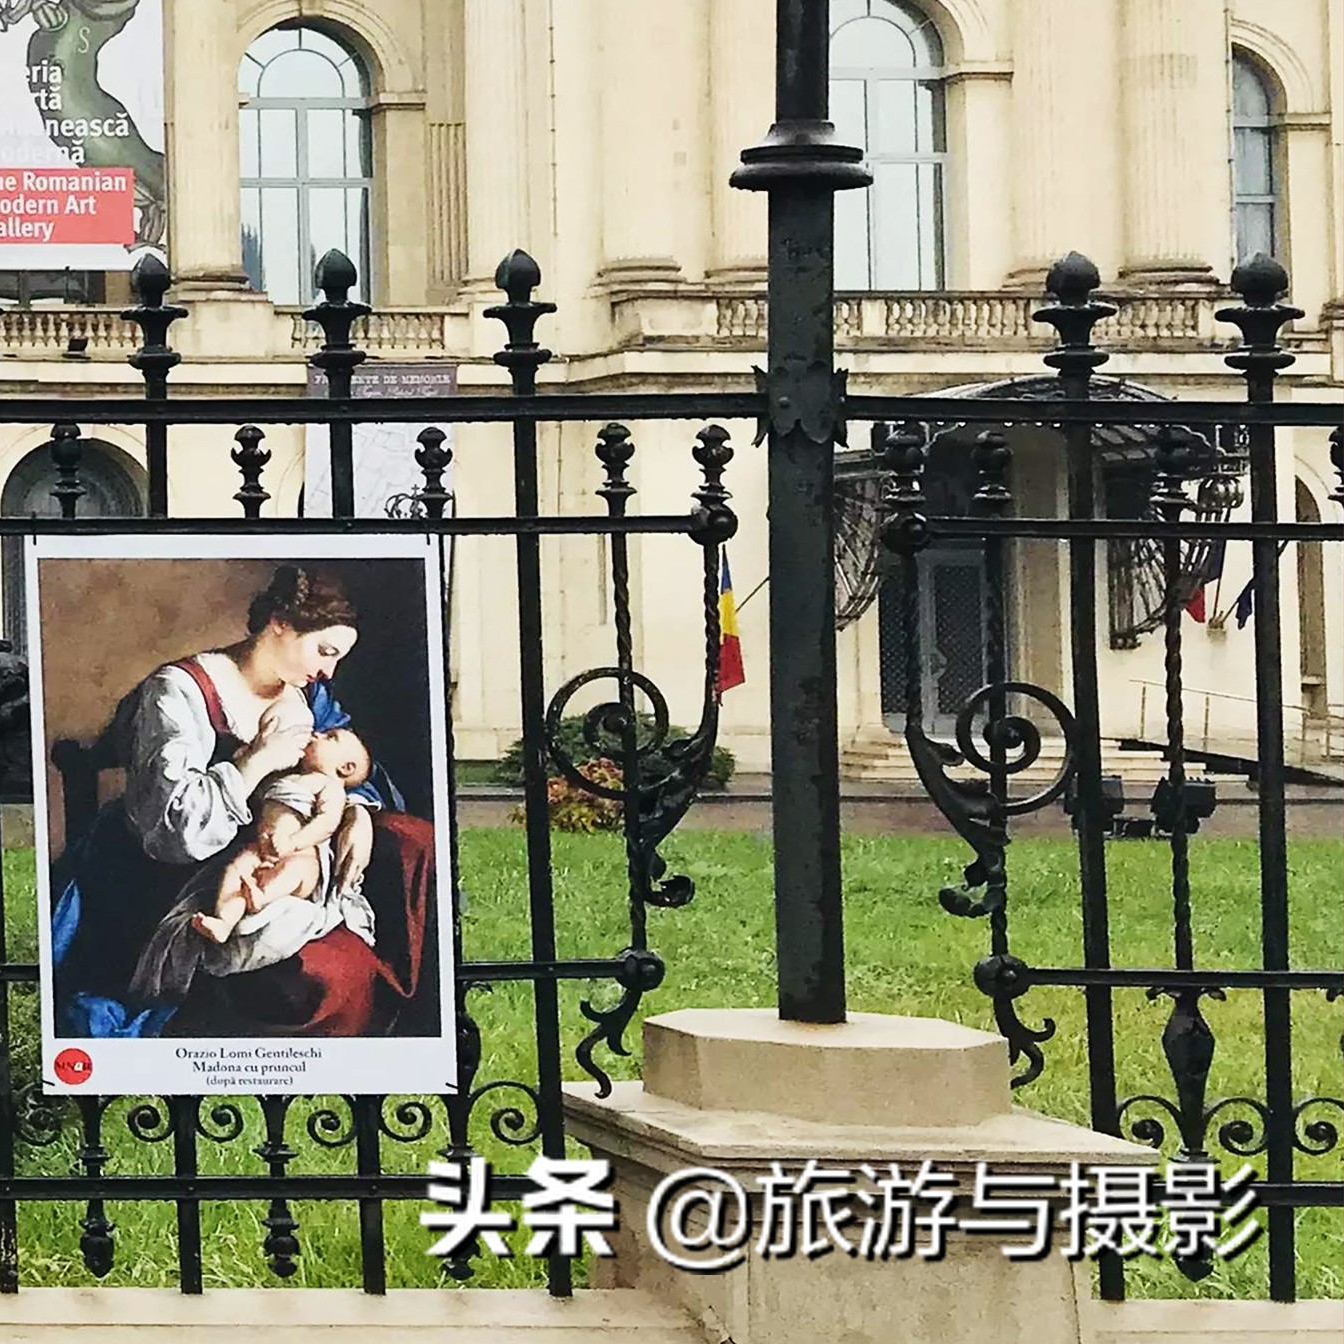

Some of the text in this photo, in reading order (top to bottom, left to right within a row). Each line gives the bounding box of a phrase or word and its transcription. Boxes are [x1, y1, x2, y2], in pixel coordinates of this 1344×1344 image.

[23, 171, 126, 191] Romanian
[64, 195, 96, 215] Art
[175, 1047, 322, 1059] Orazio Lomi Gentileschi
[193, 1061, 306, 1076] Madona cu pruncul
[206, 1076, 294, 1087] (după restaurare)
